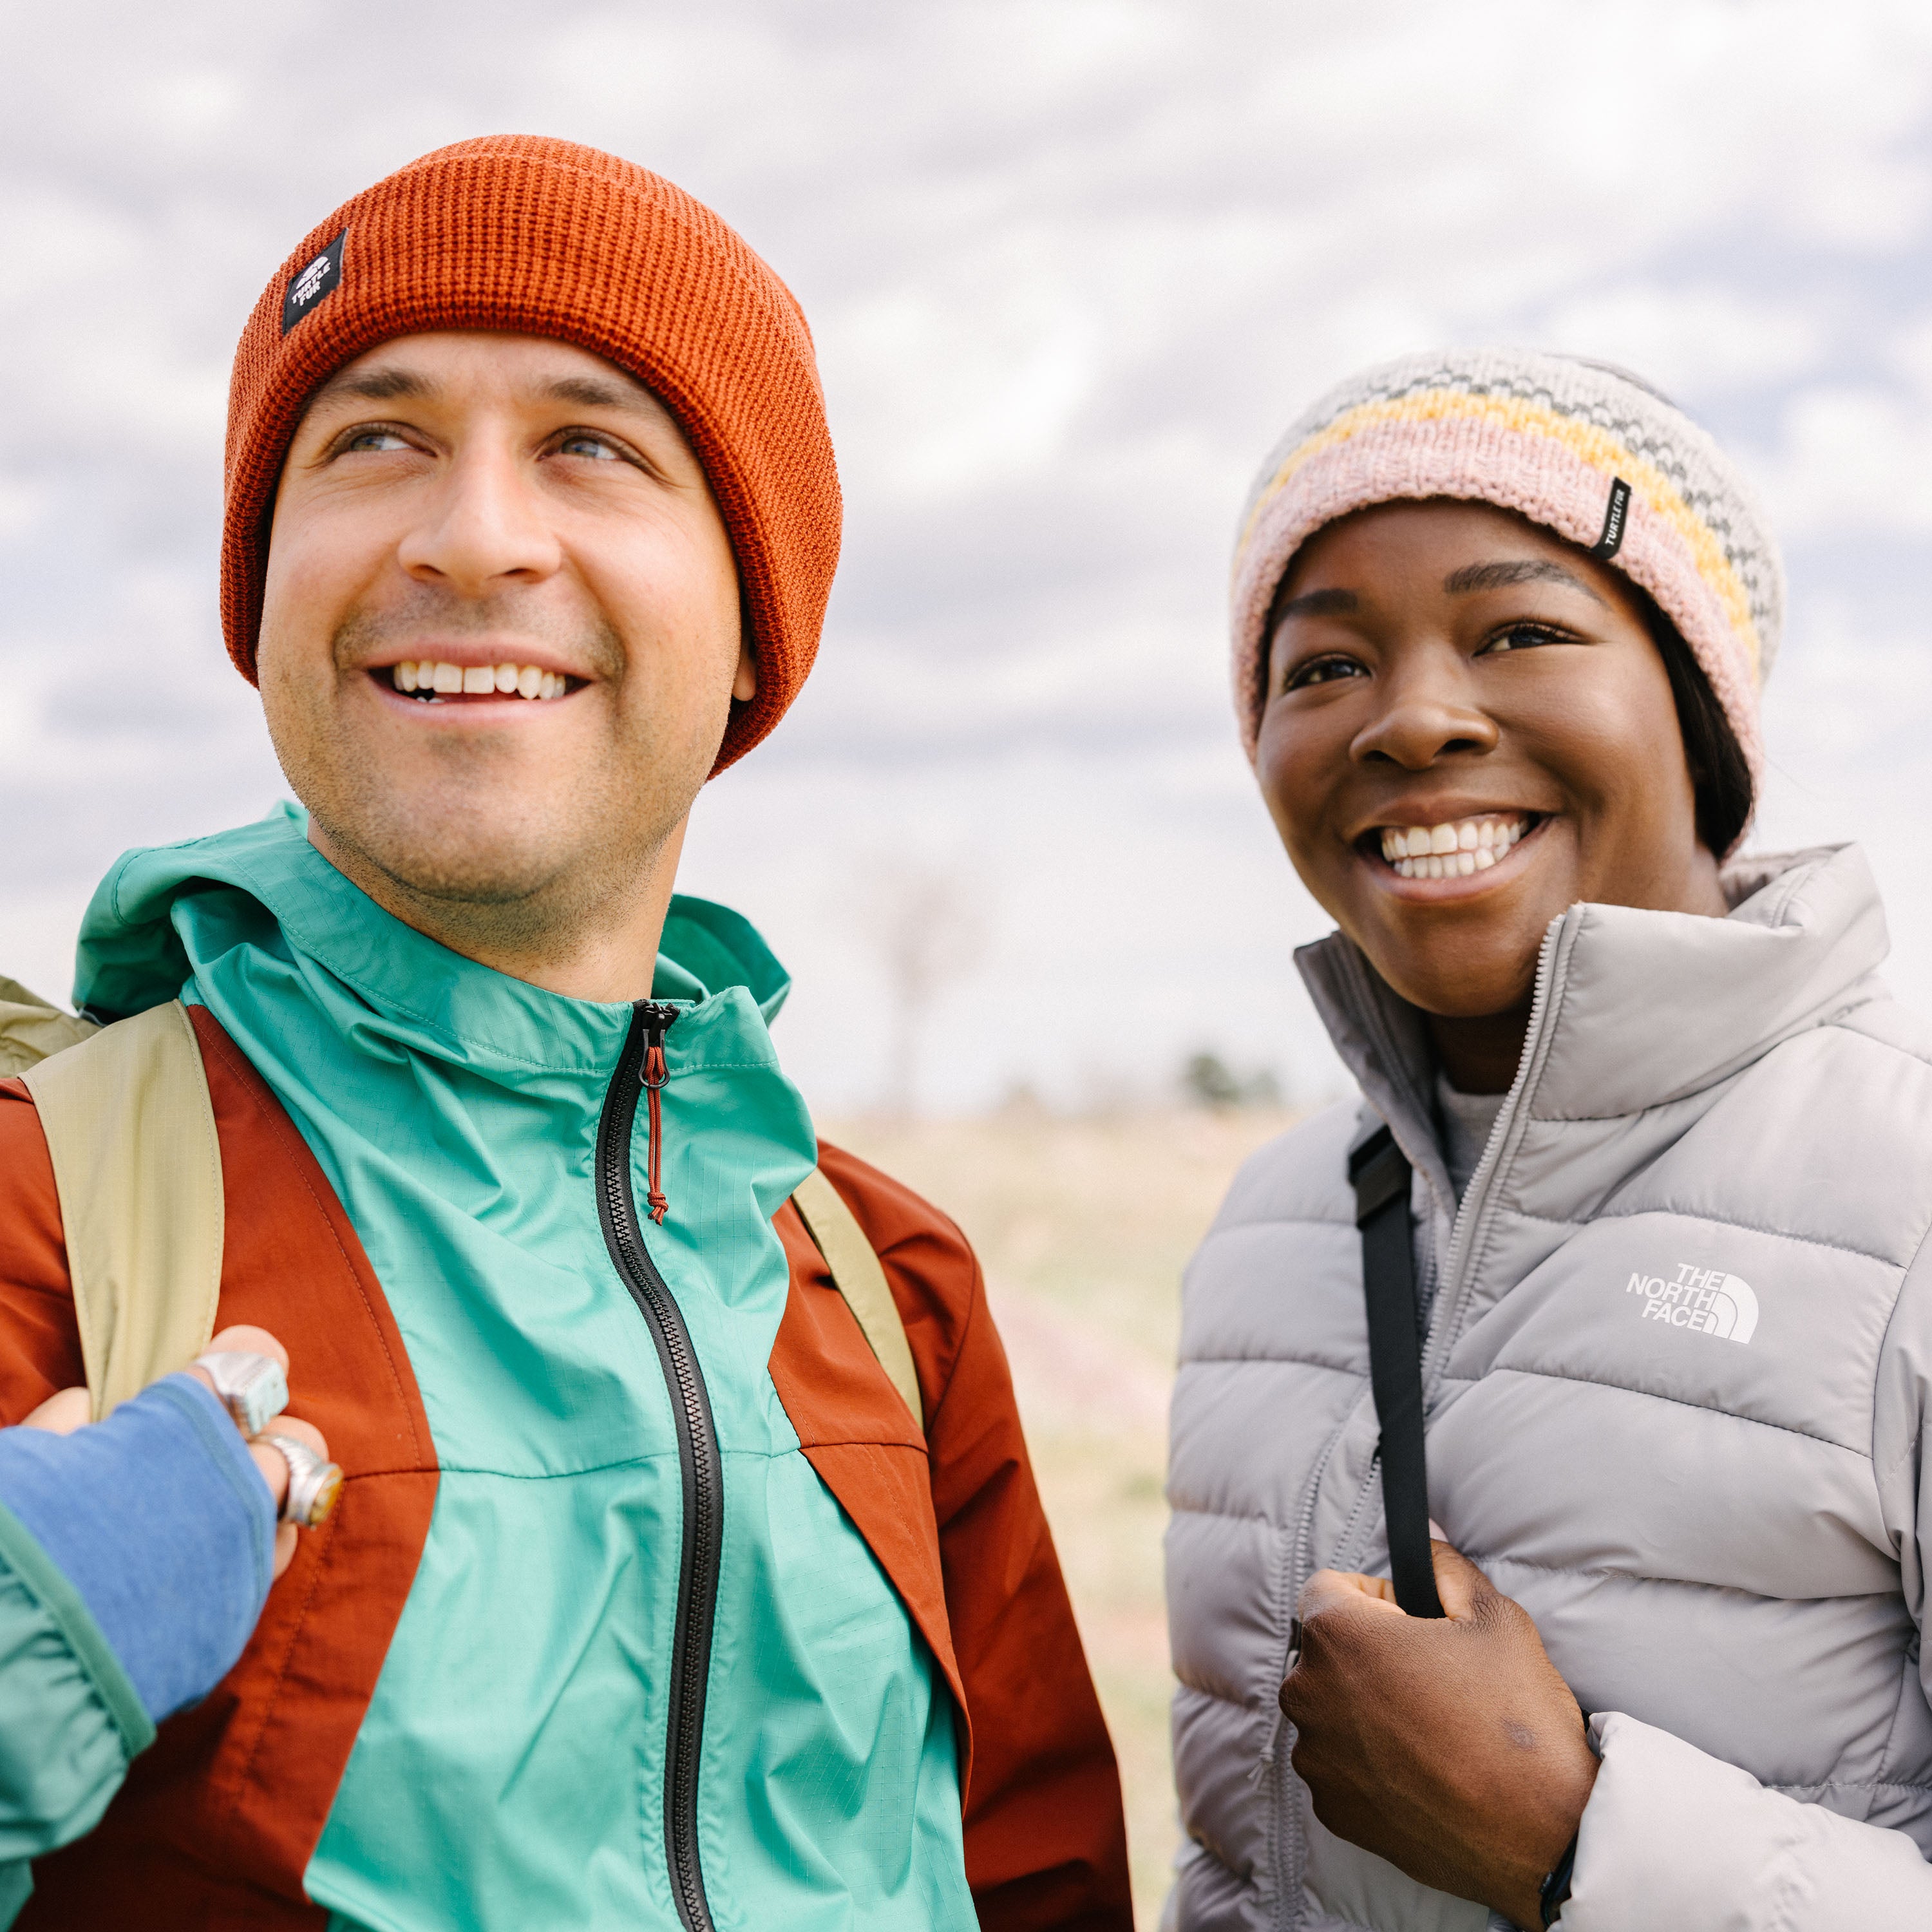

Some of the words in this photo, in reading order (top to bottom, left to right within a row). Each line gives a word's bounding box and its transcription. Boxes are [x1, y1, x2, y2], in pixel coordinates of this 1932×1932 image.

[292, 262, 331, 304] TURTLE
[299, 281, 321, 306] FUR
[1605, 506, 1622, 545] TURTLE
[1626, 1273, 1717, 1311] NORTH
[1678, 1263, 1726, 1291] THE
[1642, 1298, 1708, 1331] FACE
